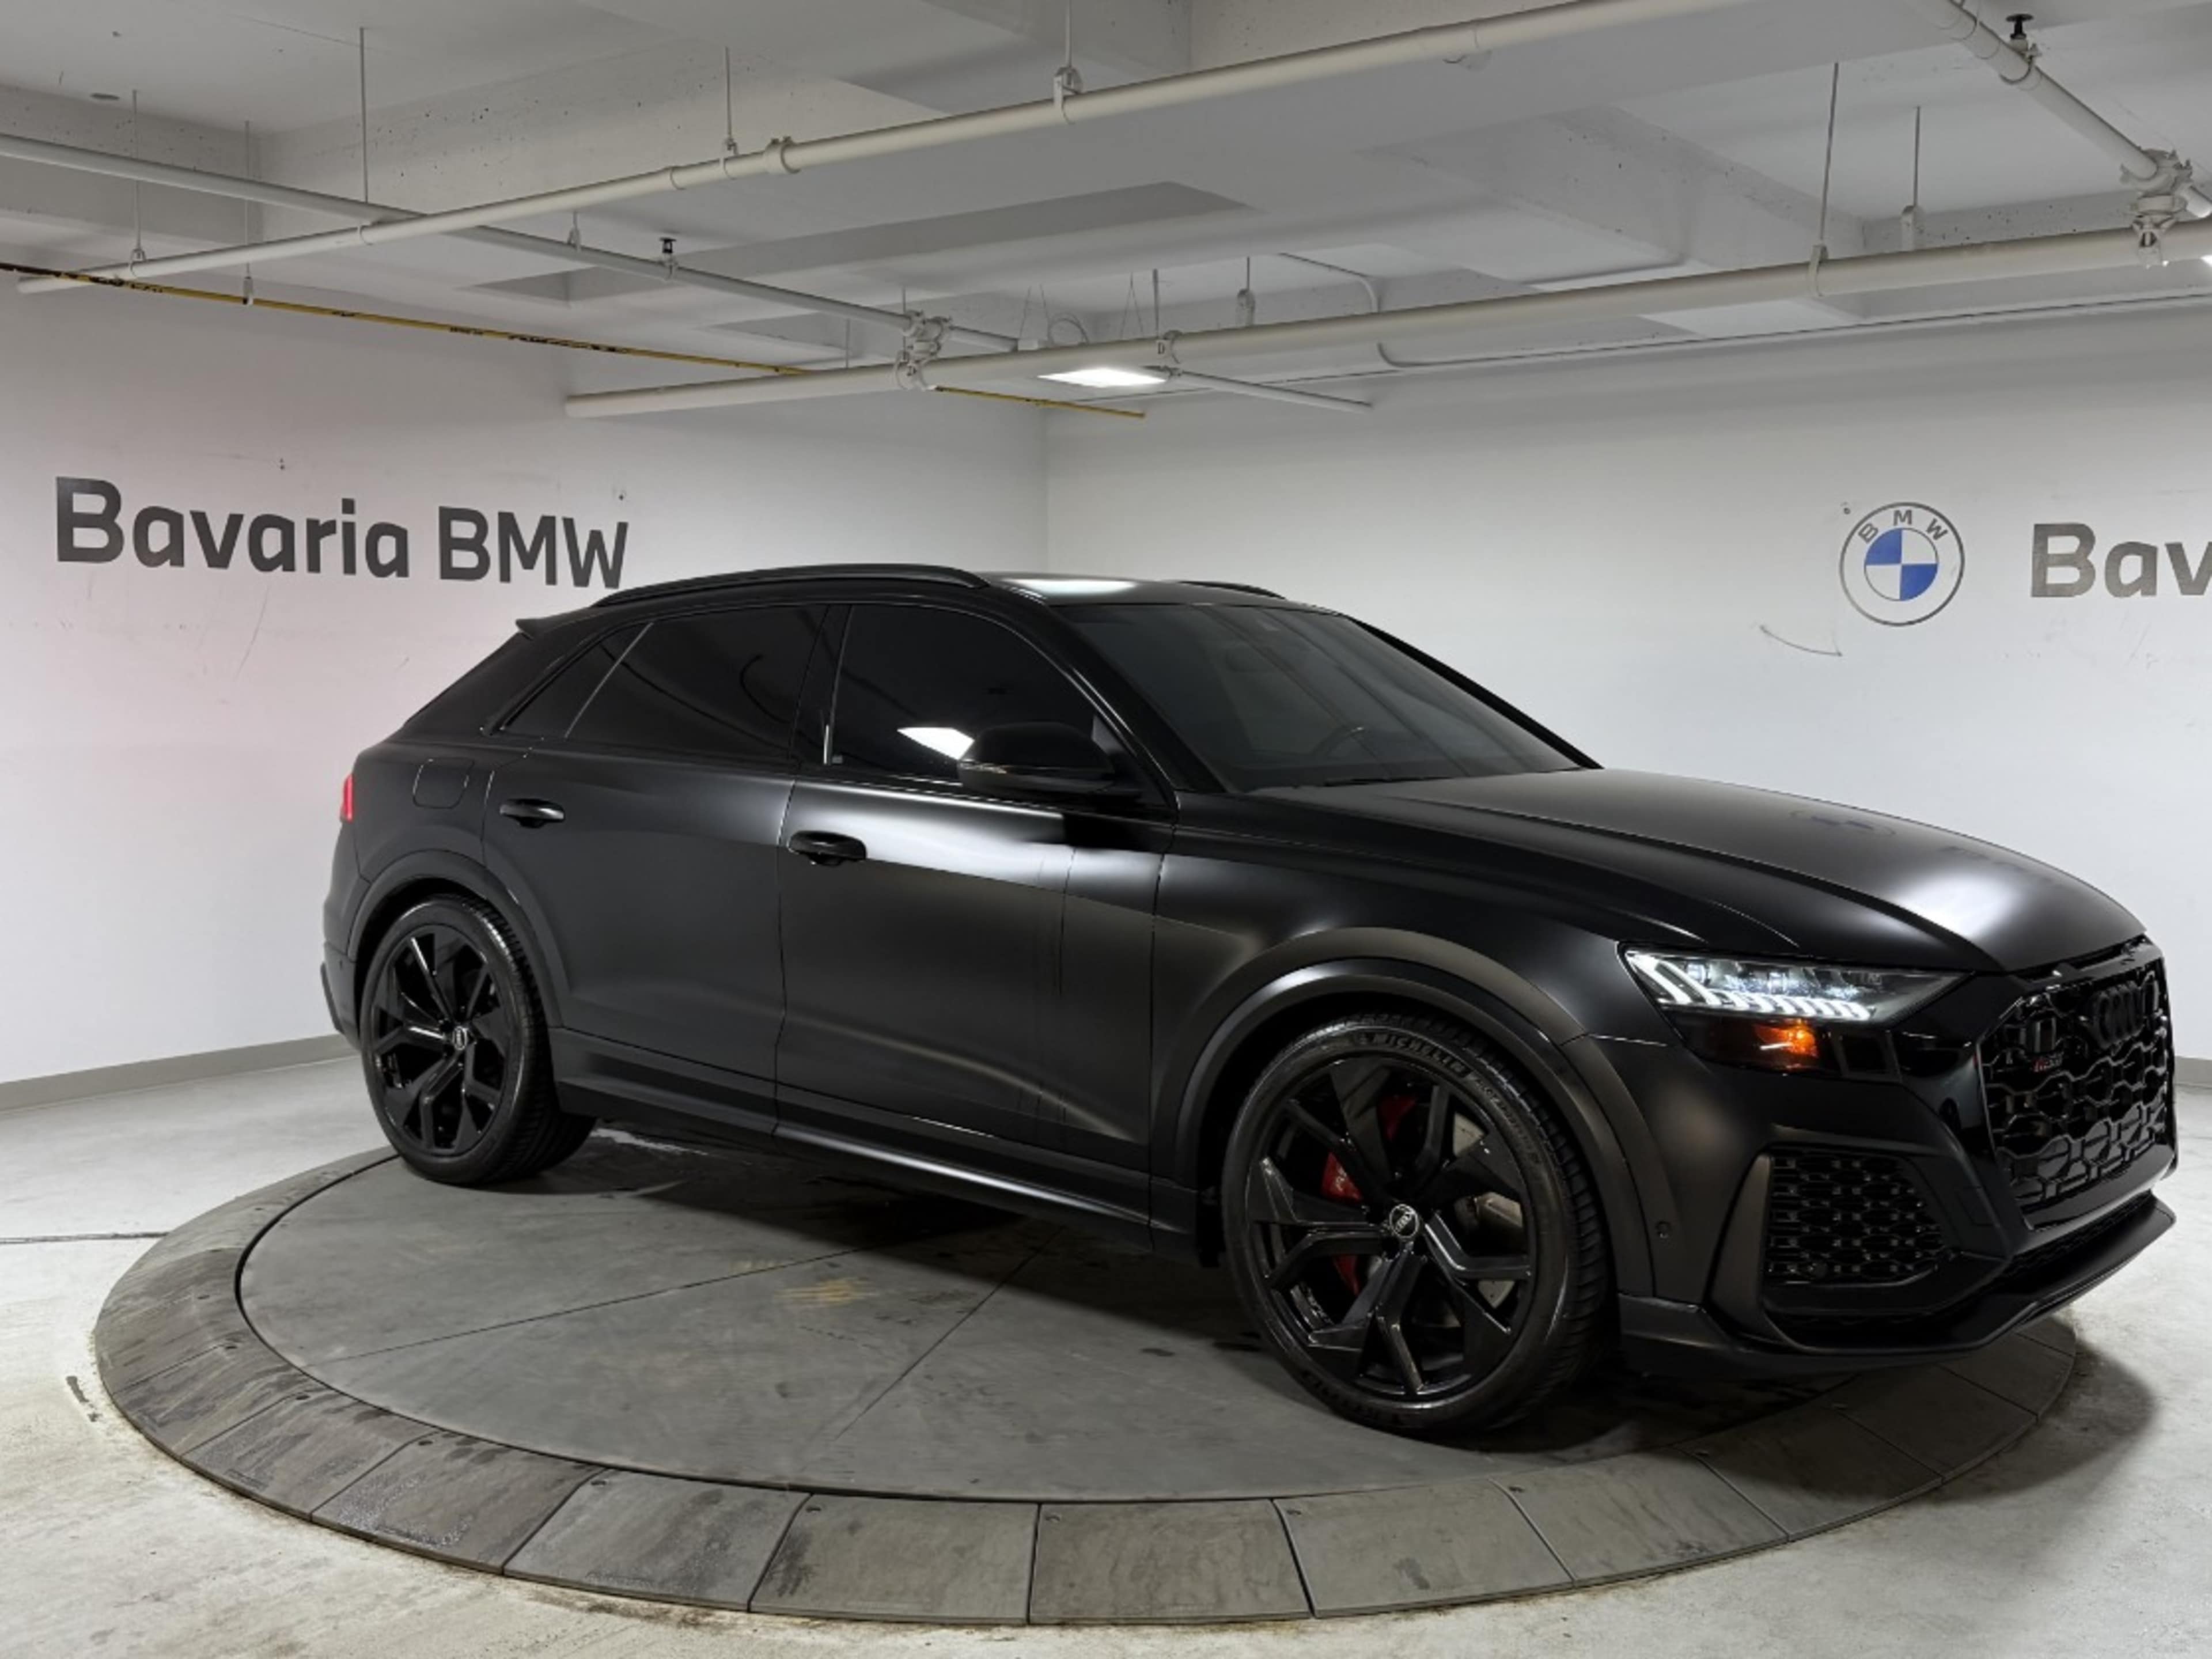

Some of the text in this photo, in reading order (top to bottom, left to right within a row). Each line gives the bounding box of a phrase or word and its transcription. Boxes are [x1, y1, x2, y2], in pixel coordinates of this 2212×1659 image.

[56, 476, 628, 589] Bavaria BMW
[1858, 509, 1948, 544] BMW
[2031, 523, 2212, 597] Bav
